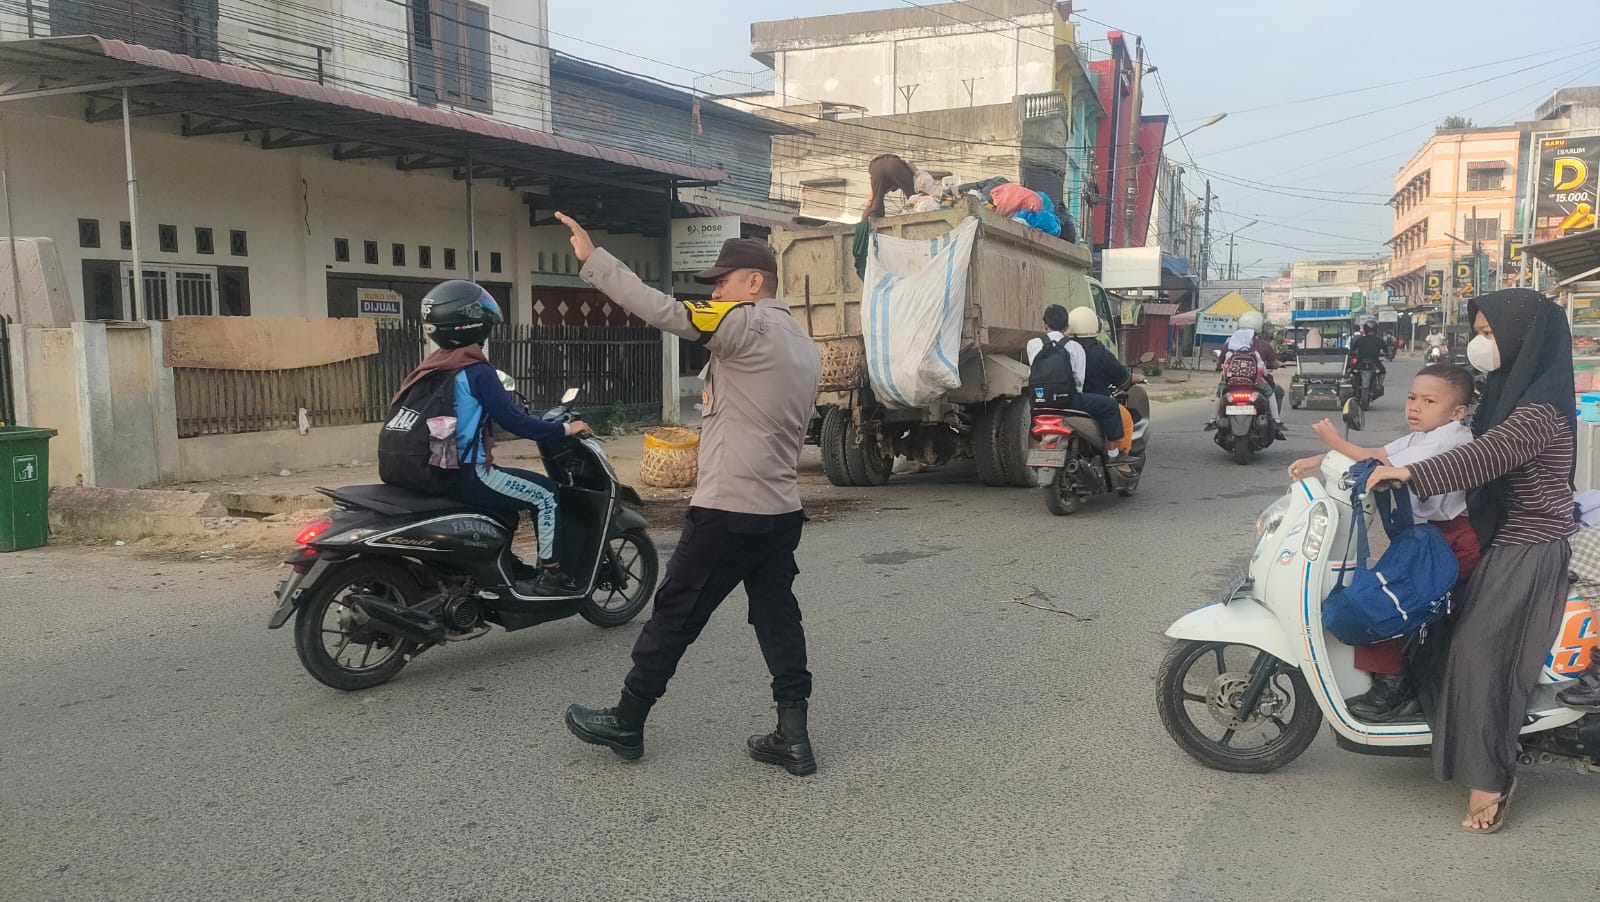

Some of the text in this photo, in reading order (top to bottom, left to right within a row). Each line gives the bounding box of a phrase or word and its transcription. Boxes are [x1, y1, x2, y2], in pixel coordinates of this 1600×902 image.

[1553, 157, 1588, 191] D
[1556, 191, 1588, 203] 15.000
[1457, 264, 1469, 278] D
[1428, 276, 1440, 287] D
[364, 302, 397, 312] DIJUAL
